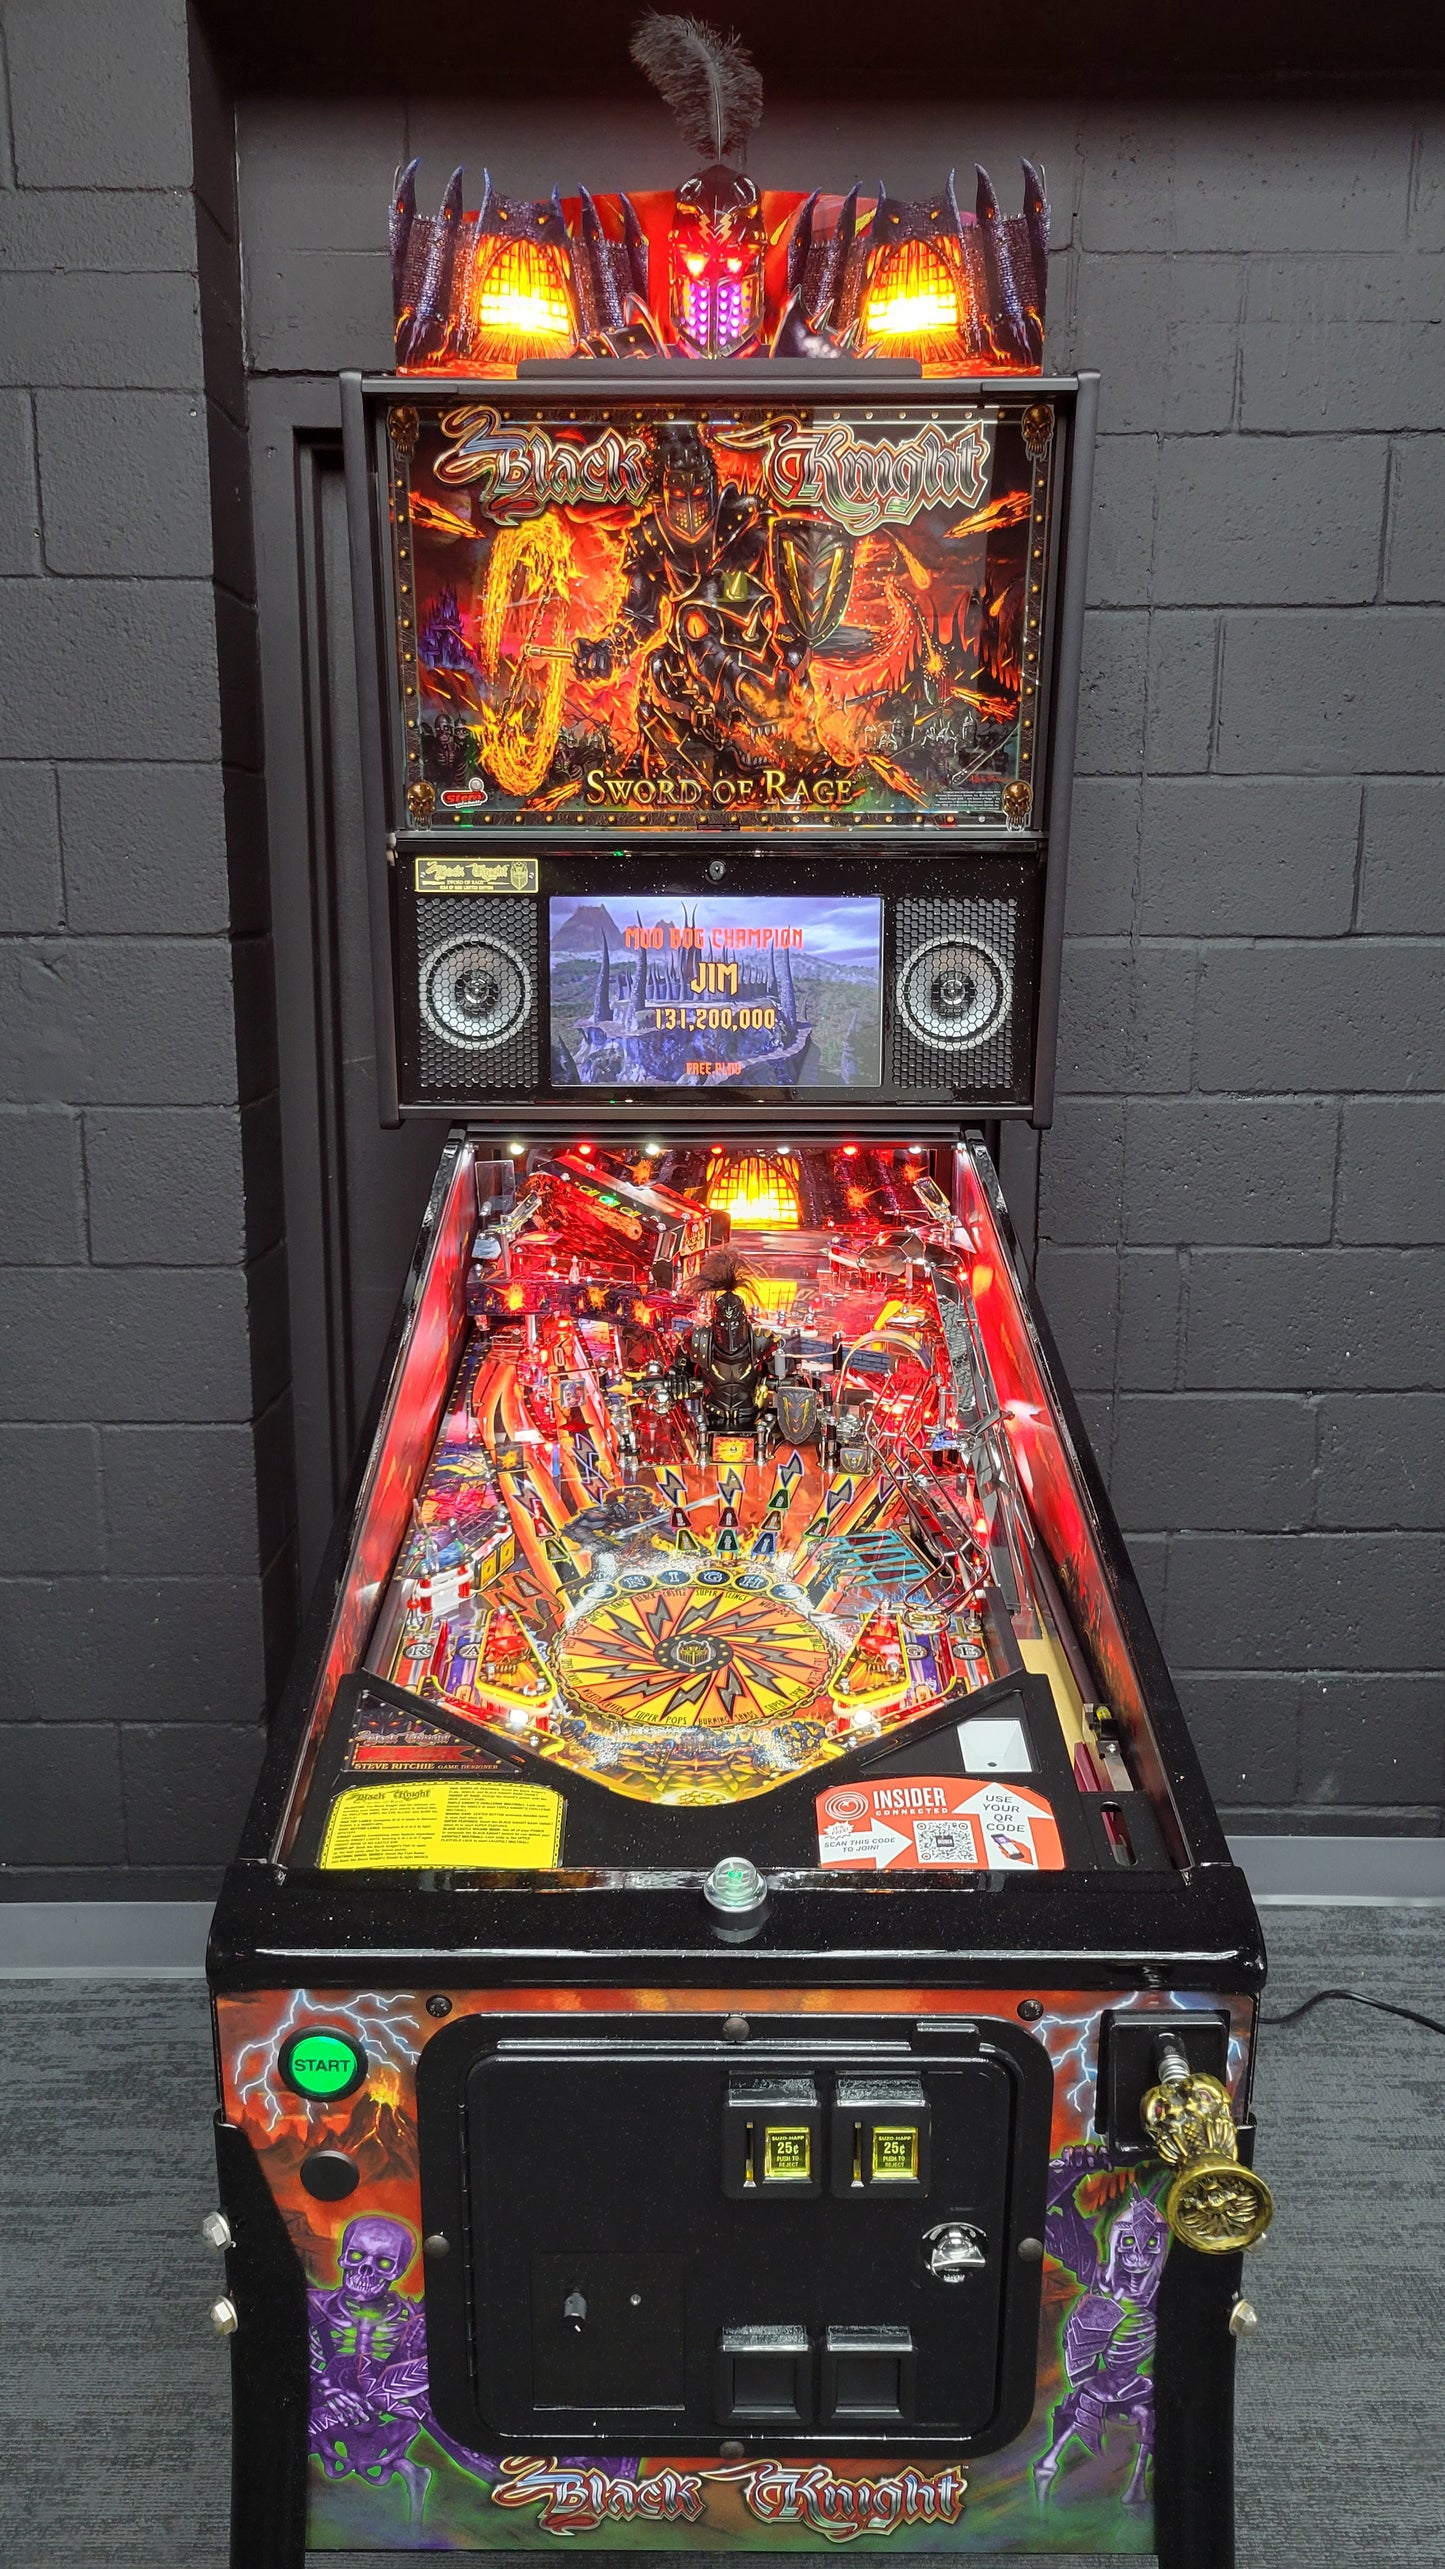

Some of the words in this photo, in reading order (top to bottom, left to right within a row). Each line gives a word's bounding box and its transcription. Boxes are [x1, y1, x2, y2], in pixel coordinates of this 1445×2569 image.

[433, 405, 649, 525] Black
[713, 414, 991, 536] Knight
[587, 769, 702, 804] SWORD
[712, 780, 752, 804] OF
[763, 769, 853, 805] RAGE
[625, 927, 664, 950] MUD
[670, 927, 705, 950] BOG
[712, 927, 803, 950] CHAMPION
[690, 962, 738, 995] JIM
[655, 1008, 775, 1032] 131,200,000
[686, 1062, 711, 1076] FREE
[714, 1062, 742, 1076] PLAY
[625, 1575, 647, 1588] N
[669, 1571, 680, 1582] I
[703, 1571, 723, 1583] G
[740, 1575, 764, 1588] H
[633, 1592, 656, 1601] BLACK
[724, 1591, 749, 1601] SLINGS
[763, 1699, 788, 1711] SUPER
[633, 1710, 658, 1720] SUPER
[698, 1715, 730, 1724] BURNING
[873, 1787, 947, 1810] INSIDER
[985, 1794, 1013, 1804] USE
[875, 1808, 949, 1816] CONNECTED
[982, 1803, 1020, 1813] YOUR
[993, 1813, 1013, 1823] QR
[986, 1823, 1026, 1833] CODE
[824, 1840, 848, 1848] SCAN
[850, 1838, 870, 1846] THIS
[294, 2059, 351, 2072] START
[777, 2142, 799, 2155] 25¢
[884, 2142, 906, 2155] 25¢
[491, 2456, 706, 2536] Black
